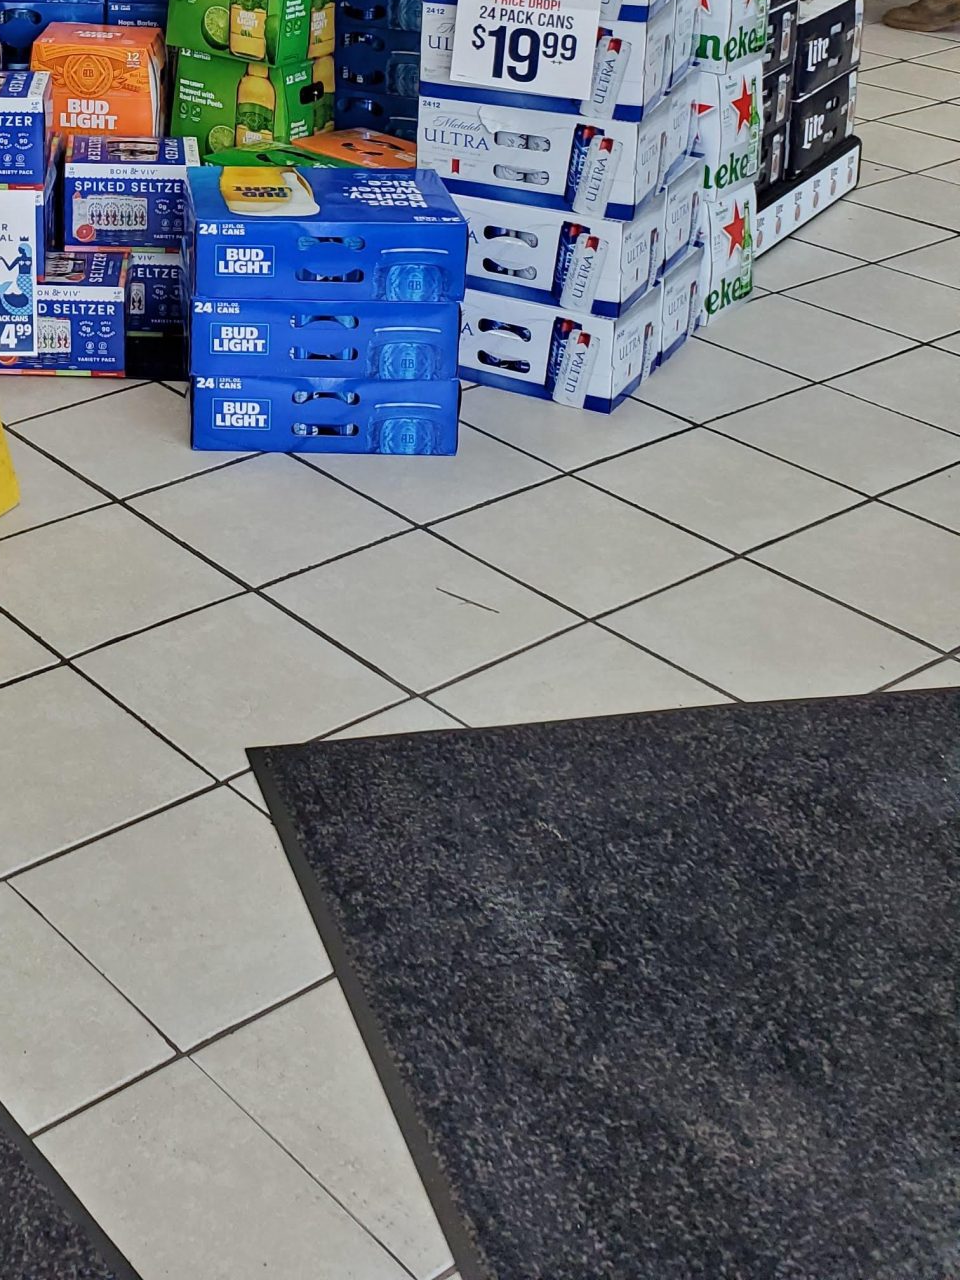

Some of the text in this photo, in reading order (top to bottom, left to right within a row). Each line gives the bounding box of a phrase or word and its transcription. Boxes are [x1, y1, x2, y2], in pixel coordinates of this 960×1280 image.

[479, 5, 574, 30] 24 PACK CANS
[126, 51, 140, 62] 12
[806, 36, 829, 72] Lite
[593, 58, 616, 105] ULTRA
[68, 99, 110, 114] BUD
[60, 114, 117, 130] LIGHT
[433, 115, 481, 132] Michelob
[802, 113, 825, 150] Lite
[424, 127, 489, 151] ULTRA
[362, 179, 416, 187] Rice.
[586, 157, 607, 202] ULTRA
[74, 181, 125, 192] SPIKED
[342, 186, 418, 194] Water.
[248, 191, 289, 199] BUD
[342, 192, 423, 201] Barley.
[365, 200, 428, 208] Hops.
[199, 223, 218, 235] 24
[222, 227, 245, 235] CANS
[226, 248, 264, 262] BUD
[218, 261, 271, 274] LIGHT
[53, 304, 115, 316] SELTZER
[194, 302, 213, 313] 24
[217, 306, 240, 314] CANS
[221, 326, 258, 340] BUD
[213, 339, 266, 352] LIGHT
[565, 350, 586, 394] ULTRA
[196, 377, 215, 389] 24
[219, 381, 242, 389] CANS
[223, 402, 260, 415] BUD
[216, 414, 267, 427] LIGHT
